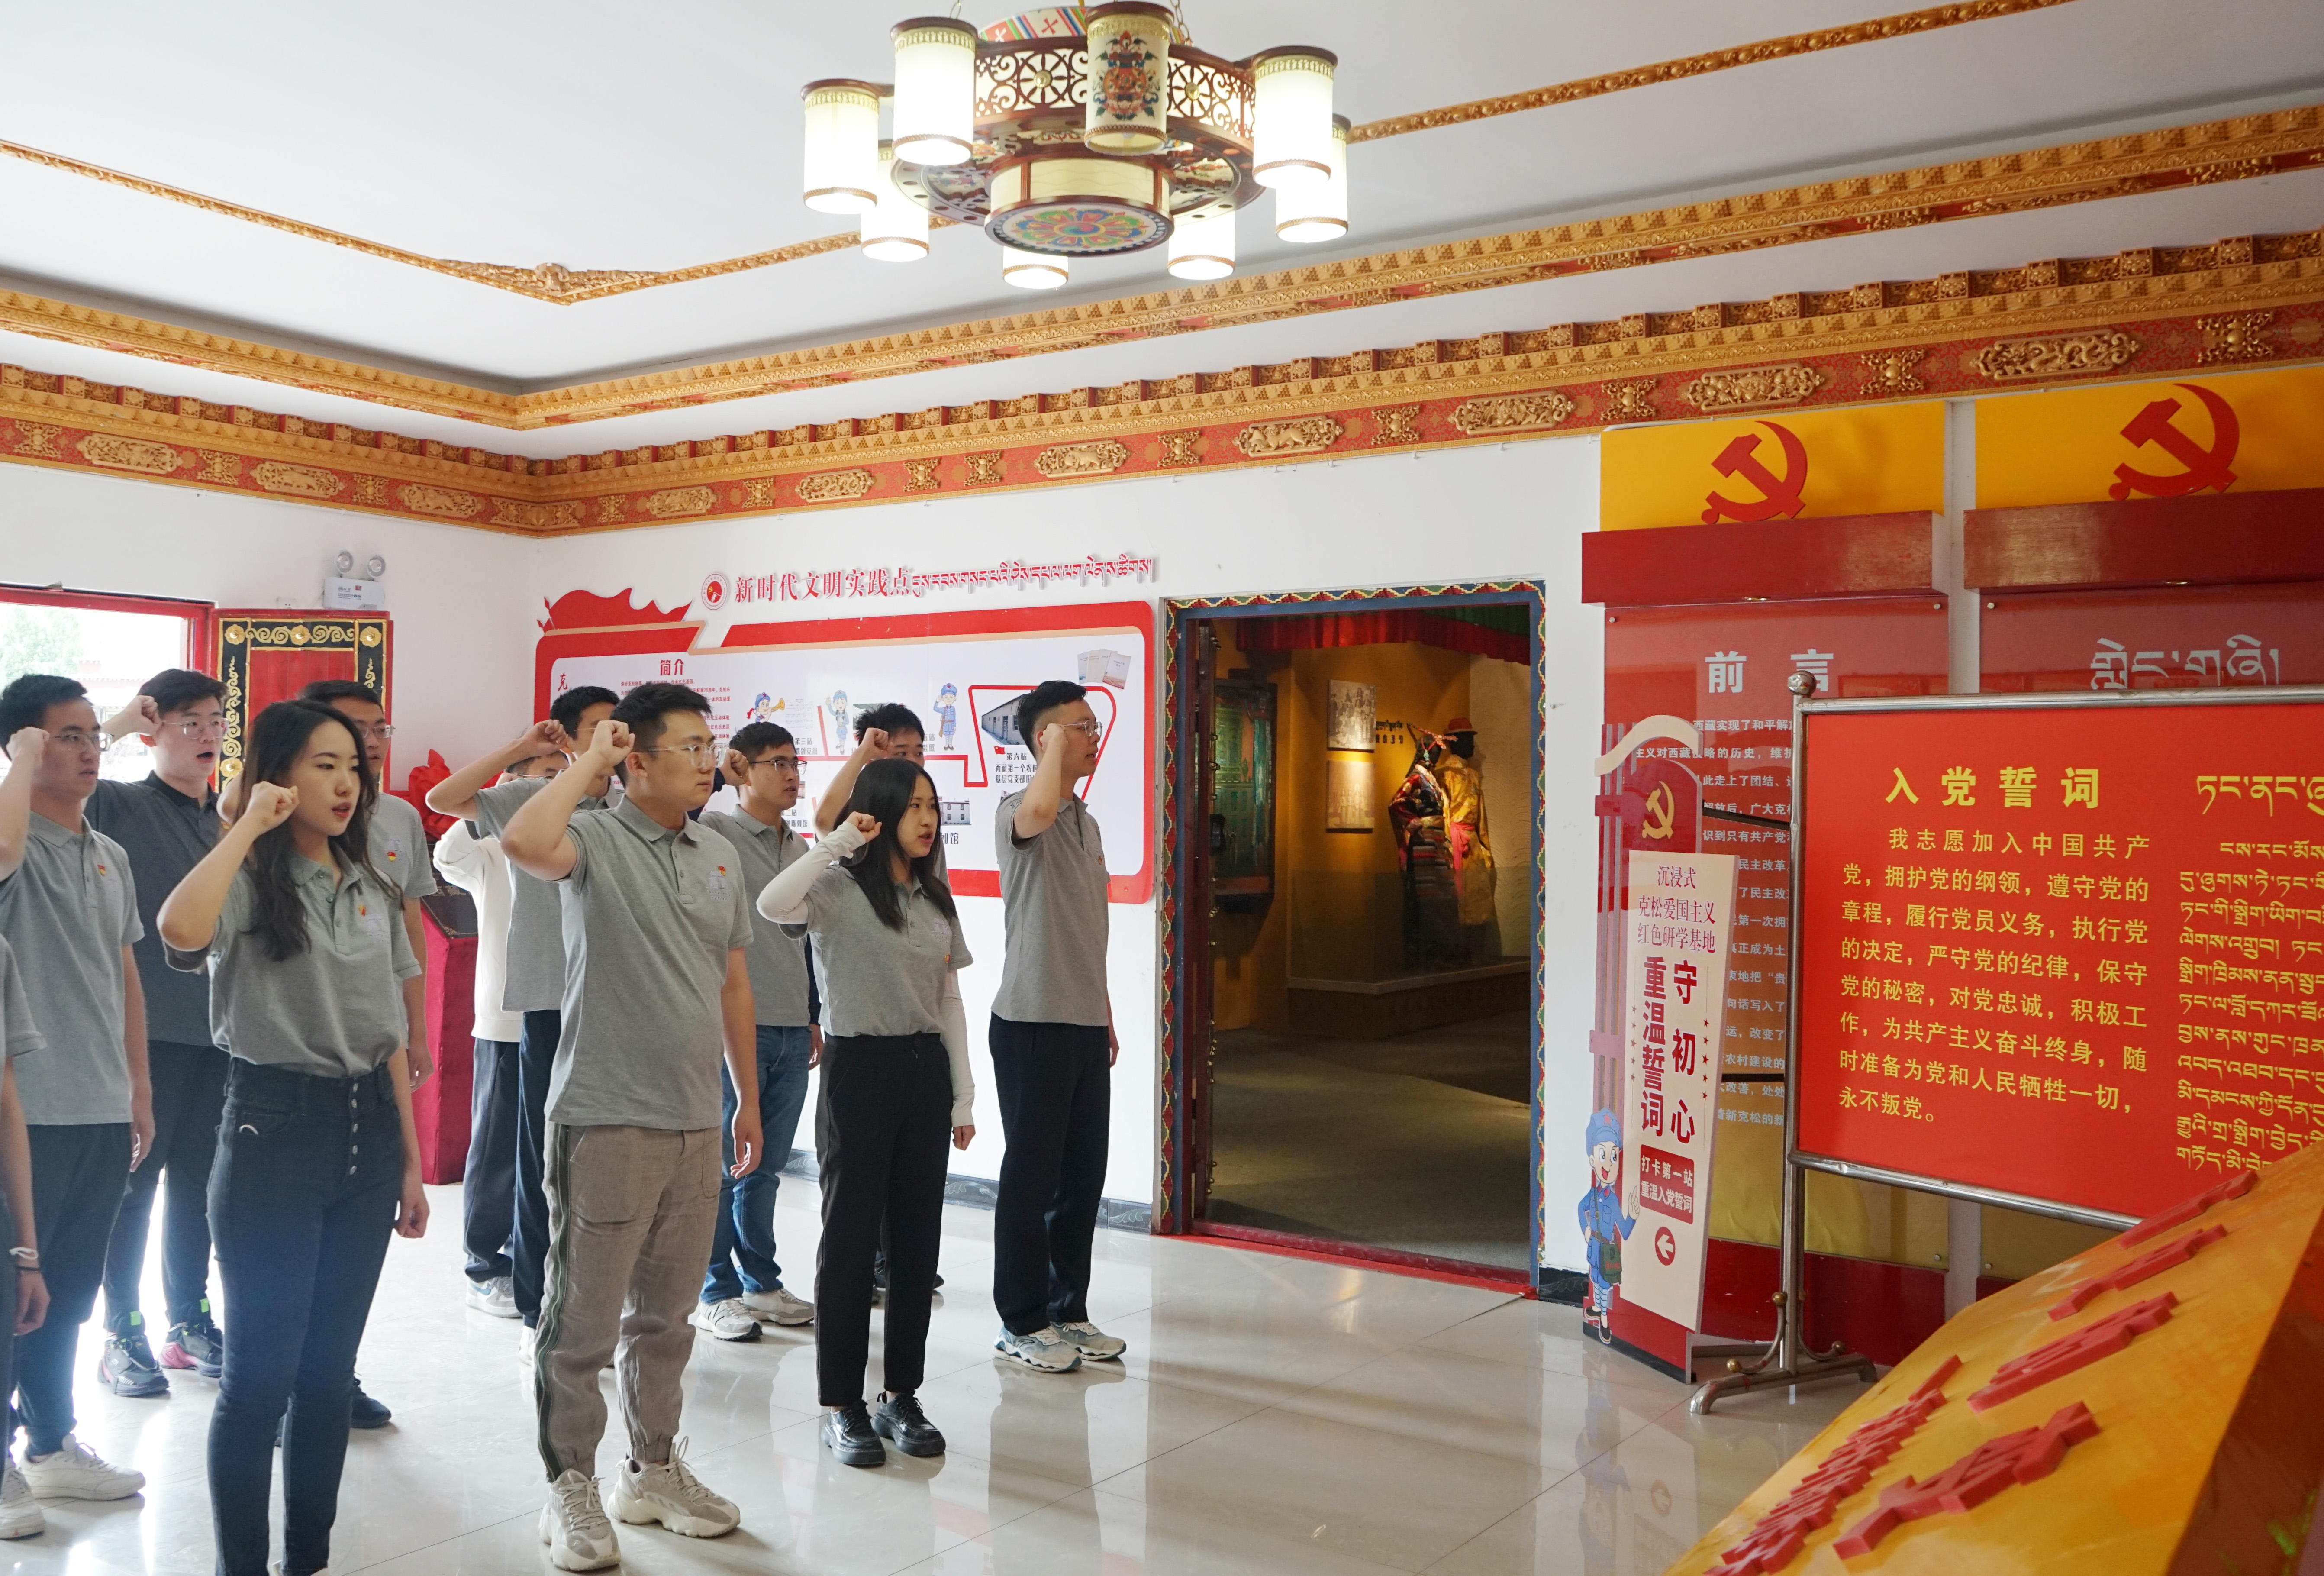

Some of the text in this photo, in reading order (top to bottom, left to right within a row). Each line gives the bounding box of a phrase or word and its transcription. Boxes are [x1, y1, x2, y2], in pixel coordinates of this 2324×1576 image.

[735, 568, 909, 603] 新时代文明实践点
[660, 659, 684, 676] 简介
[1885, 766, 2100, 808] 入党誓词
[1889, 827, 2150, 859] 我志愿加入中国共产
[1657, 865, 1696, 890] 沉浸式
[1739, 887, 1789, 899] 了民主改
[1842, 862, 2149, 902] 党，拥护党的纲领，遵守党的
[1638, 894, 1715, 925] 克松爱国主义
[1734, 914, 1788, 928] 第一次拥
[1842, 900, 2148, 944] 章程，履行党员义务，执行党
[1637, 922, 1715, 954] 红色研学基地
[1841, 937, 2148, 986] 的决定，严守党的纪律，保守
[1841, 974, 2147, 1028] 党的秘密，对党忠诚，积极工
[1641, 956, 1667, 1137] 重温誓词
[1670, 959, 1698, 1144] 守初心
[1840, 1011, 2147, 1072] 作，为共产主义奋斗终身，随
[1722, 1053, 1785, 1069] 农村建设的
[1840, 1049, 2132, 1114] 时准备为党和人民牺牲一切，
[1839, 1085, 1934, 1122] 永不叛党。
[1641, 1155, 1693, 1188] 打卡第一站
[1640, 1180, 1693, 1214] 重温入党誓词
